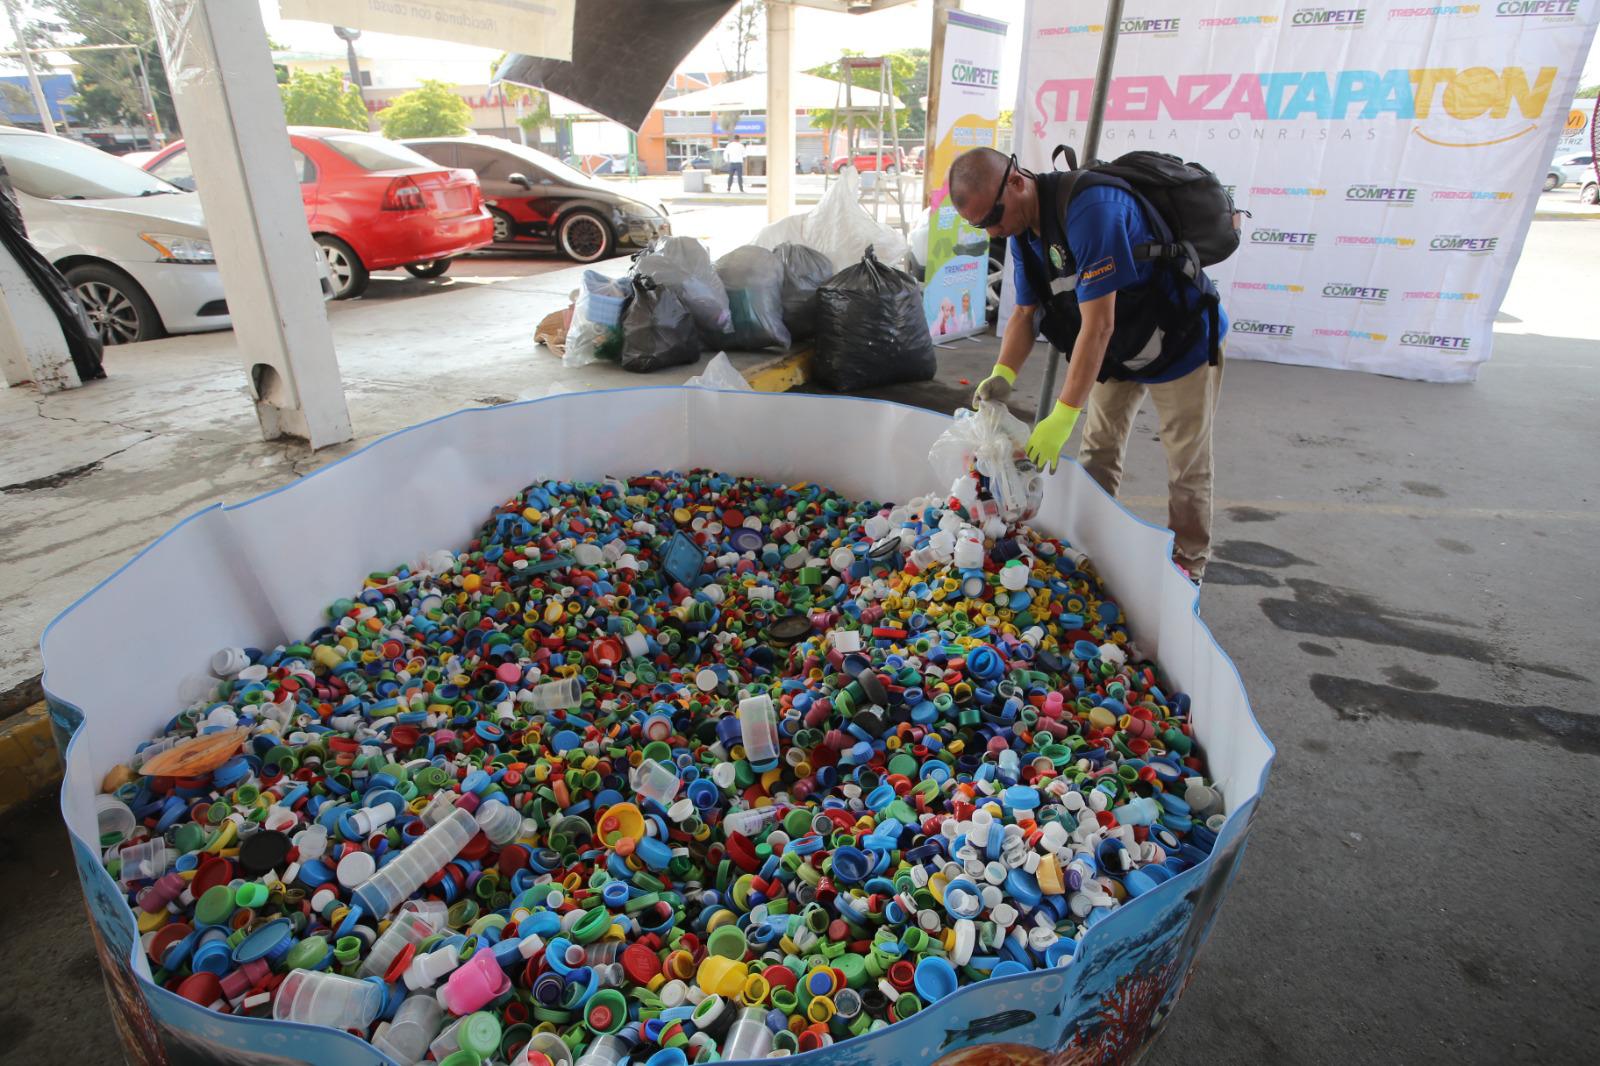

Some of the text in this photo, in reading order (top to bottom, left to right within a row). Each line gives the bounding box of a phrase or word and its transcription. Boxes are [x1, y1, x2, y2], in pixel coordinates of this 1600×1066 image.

[1497, 0, 1580, 14] COMPETE
[1292, 9, 1366, 24] COMPETE
[952, 64, 999, 85] COMPETE
[1068, 128, 1376, 140] RGALA SONRISAS
[1346, 187, 1417, 200] COMPETE
[1251, 231, 1317, 244] COMPETE
[1430, 236, 1499, 250] COMPETE
[1323, 285, 1389, 299] COMPETE
[1232, 321, 1295, 335] COMPETE
[1401, 334, 1471, 348] COMPETE
